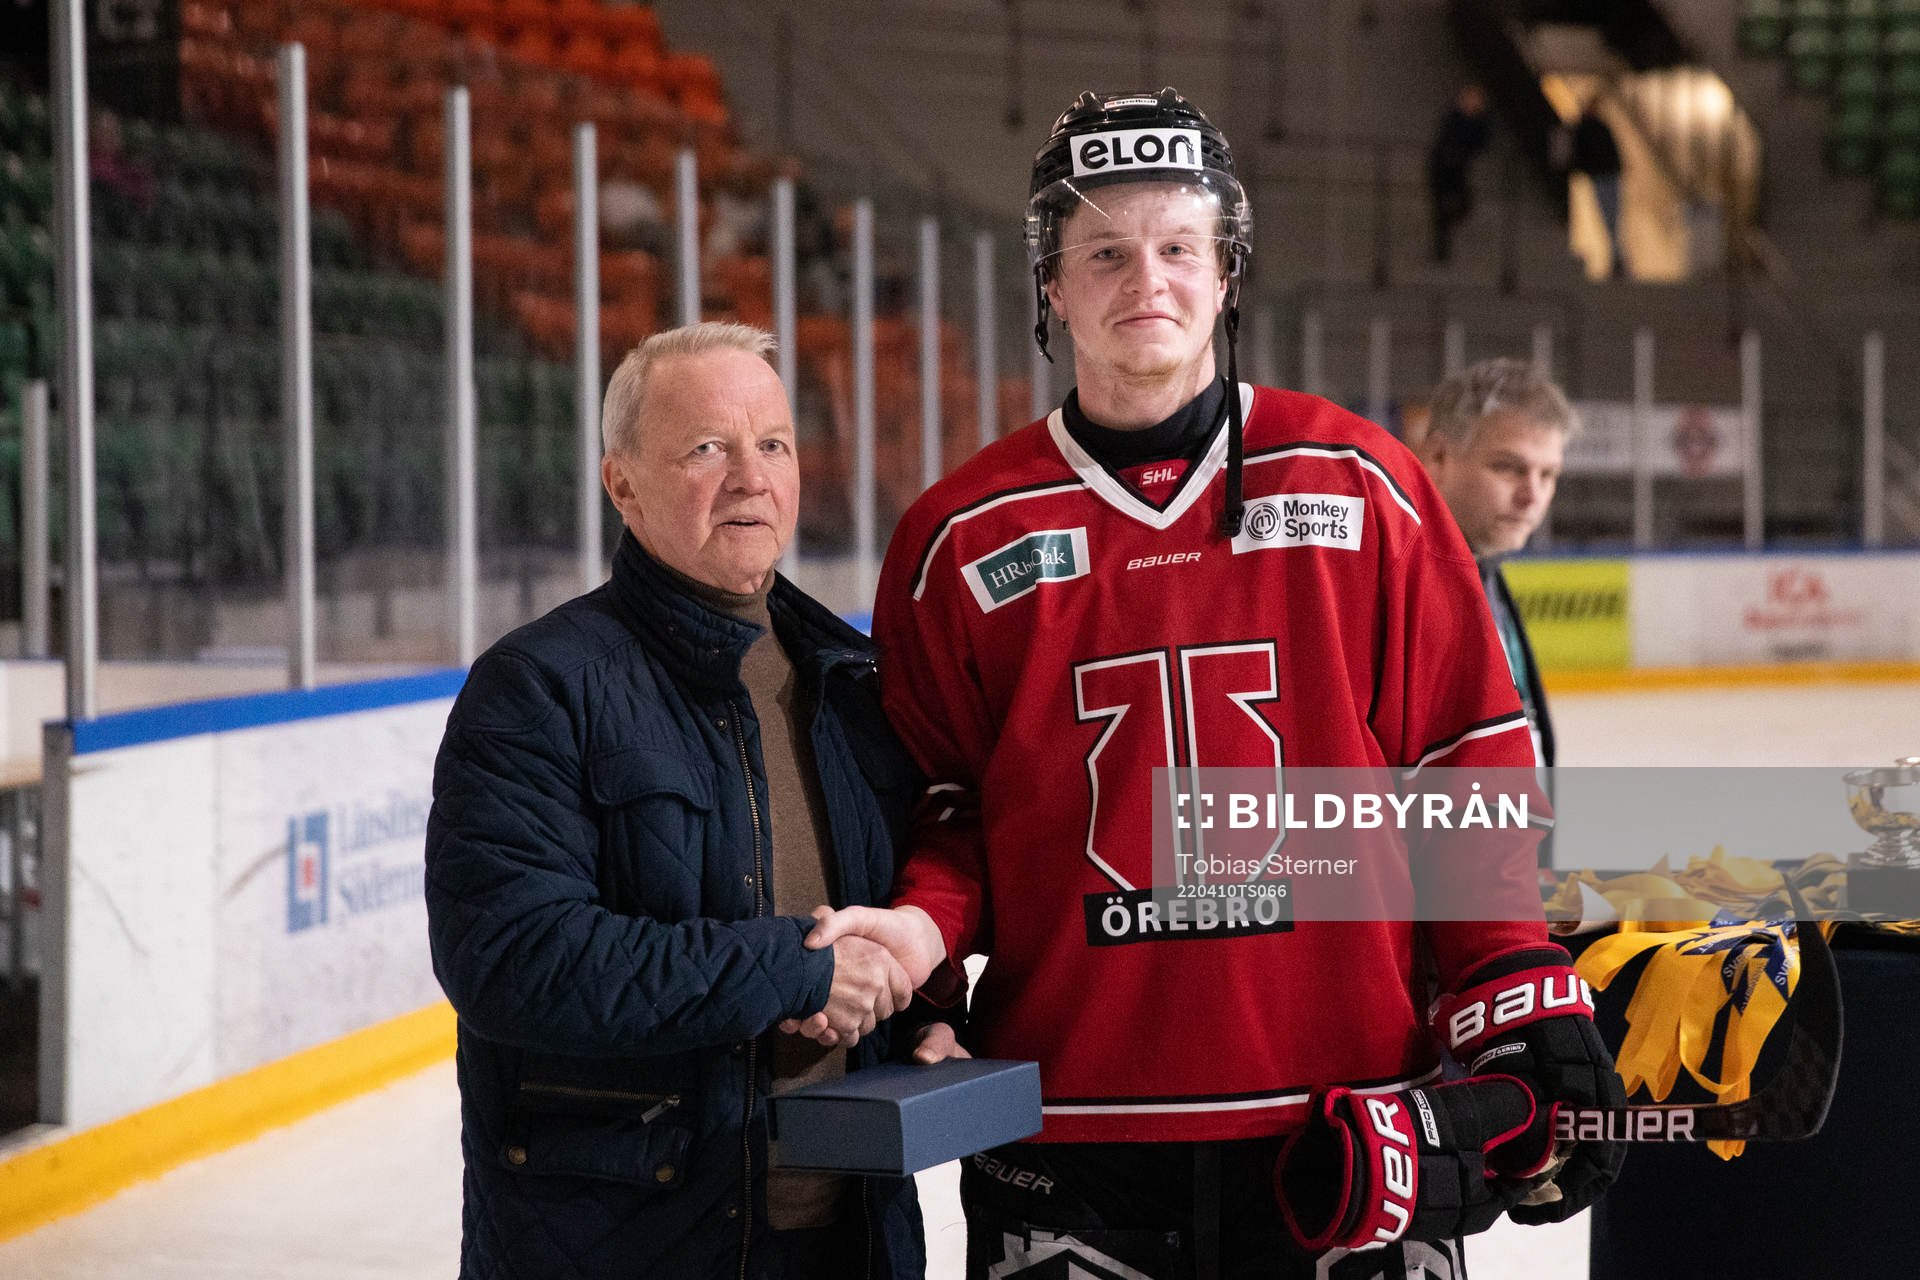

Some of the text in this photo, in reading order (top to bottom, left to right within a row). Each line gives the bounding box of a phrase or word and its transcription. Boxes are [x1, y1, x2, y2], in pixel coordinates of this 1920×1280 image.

[1142, 467, 1178, 486] SHL
[1283, 499, 1349, 522] Monkey
[1285, 518, 1348, 541] Sports
[1101, 894, 1281, 937] ÖREBRO
